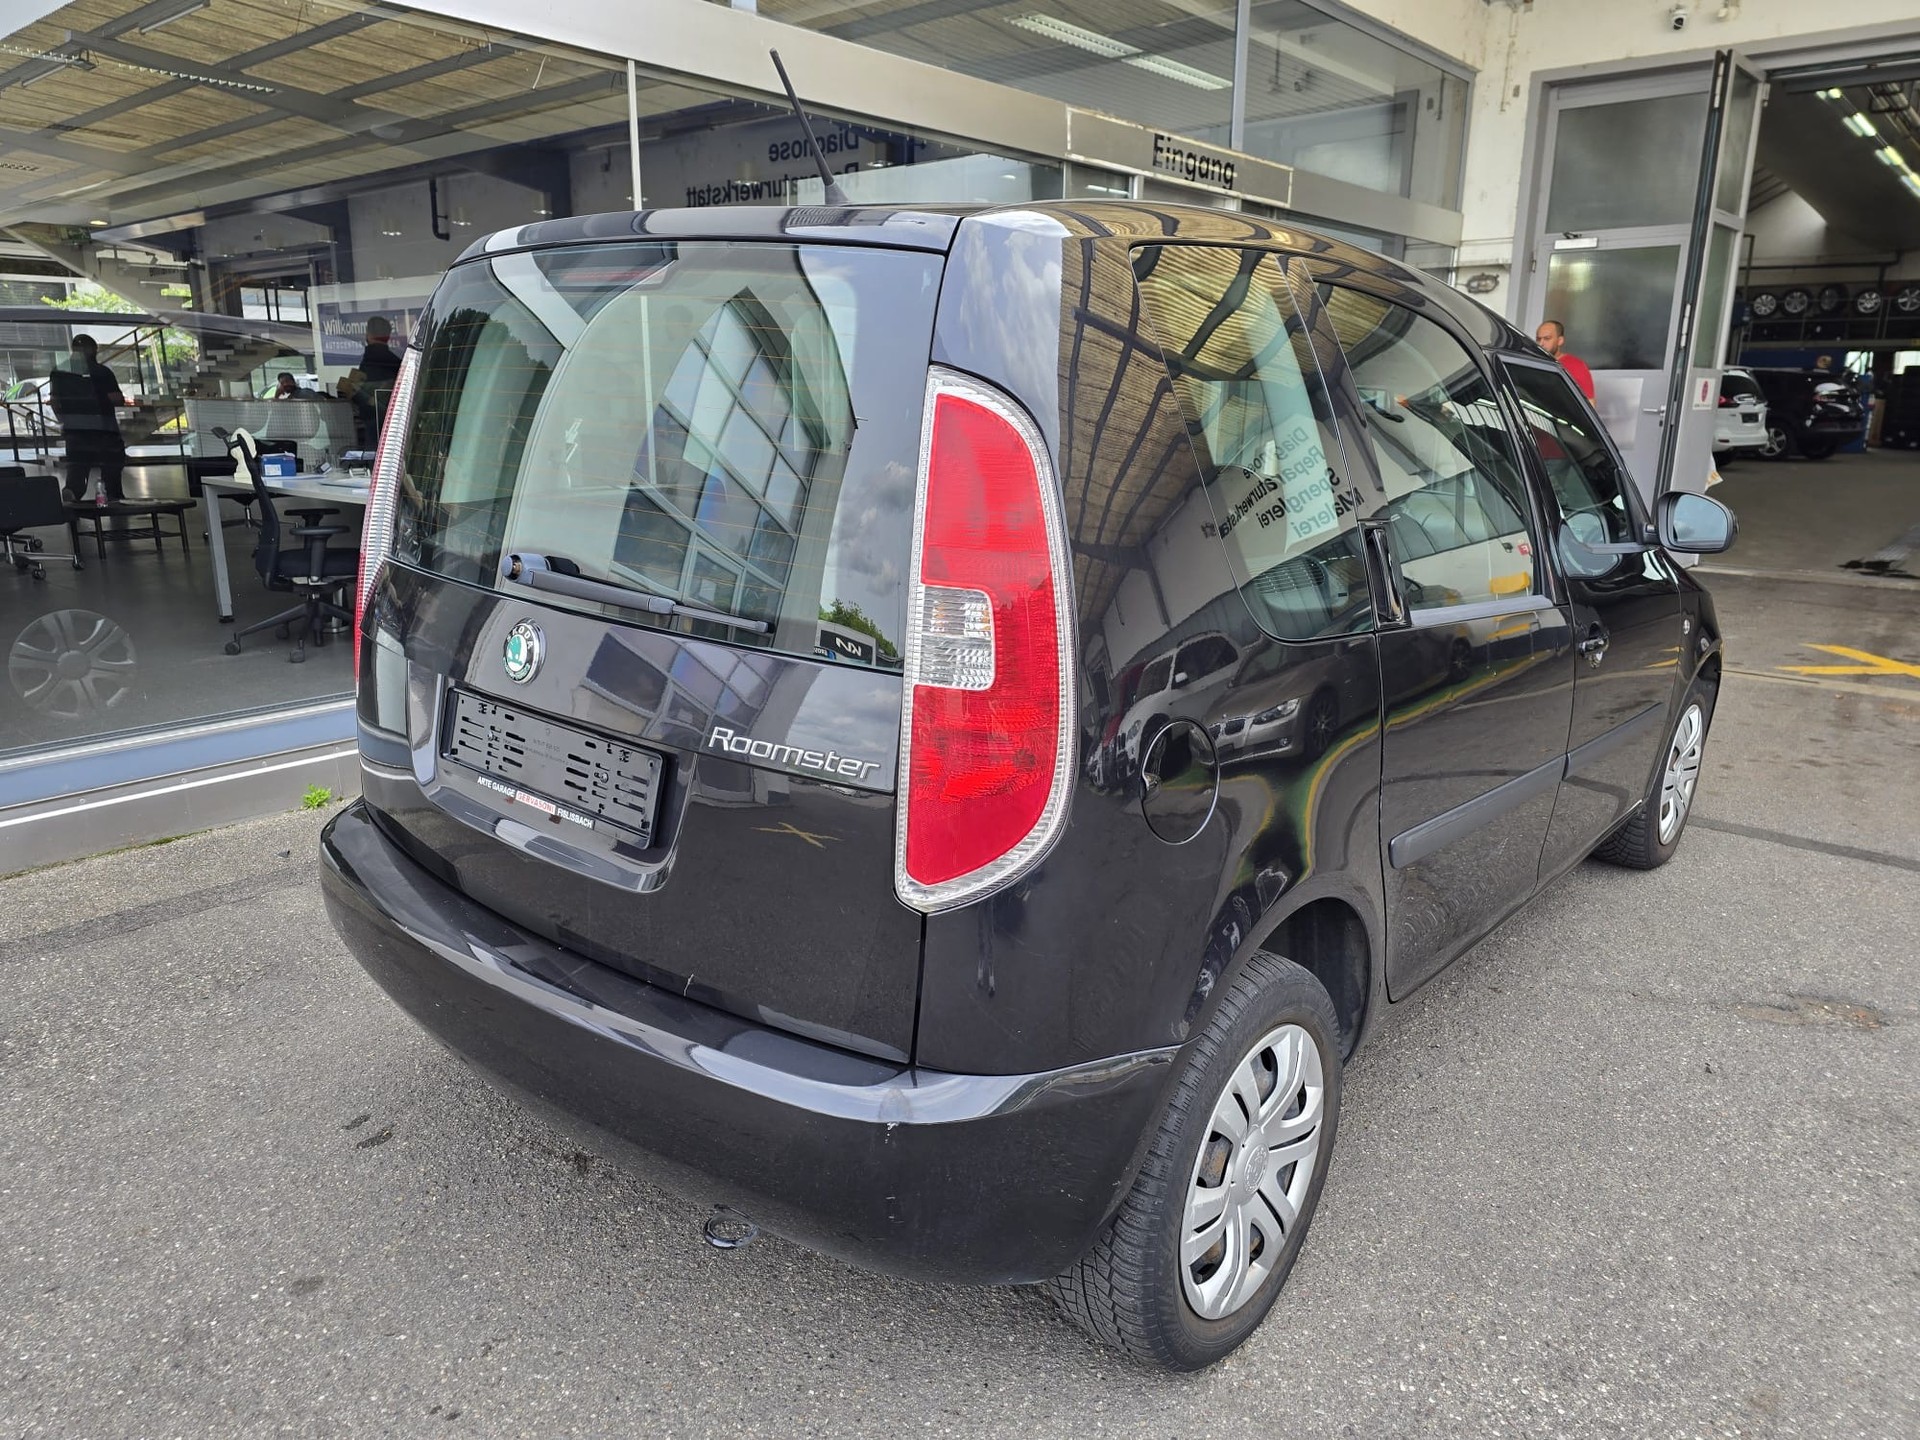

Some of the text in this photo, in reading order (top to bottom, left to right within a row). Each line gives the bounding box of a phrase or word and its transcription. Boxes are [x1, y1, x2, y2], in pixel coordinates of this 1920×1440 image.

[1152, 133, 1235, 190] Eingang
[323, 317, 368, 336] Willkomm
[708, 726, 881, 779] Roomster
[477, 776, 493, 790] ARTE
[492, 782, 516, 797] GARAGE
[516, 790, 555, 813] GERVASONI
